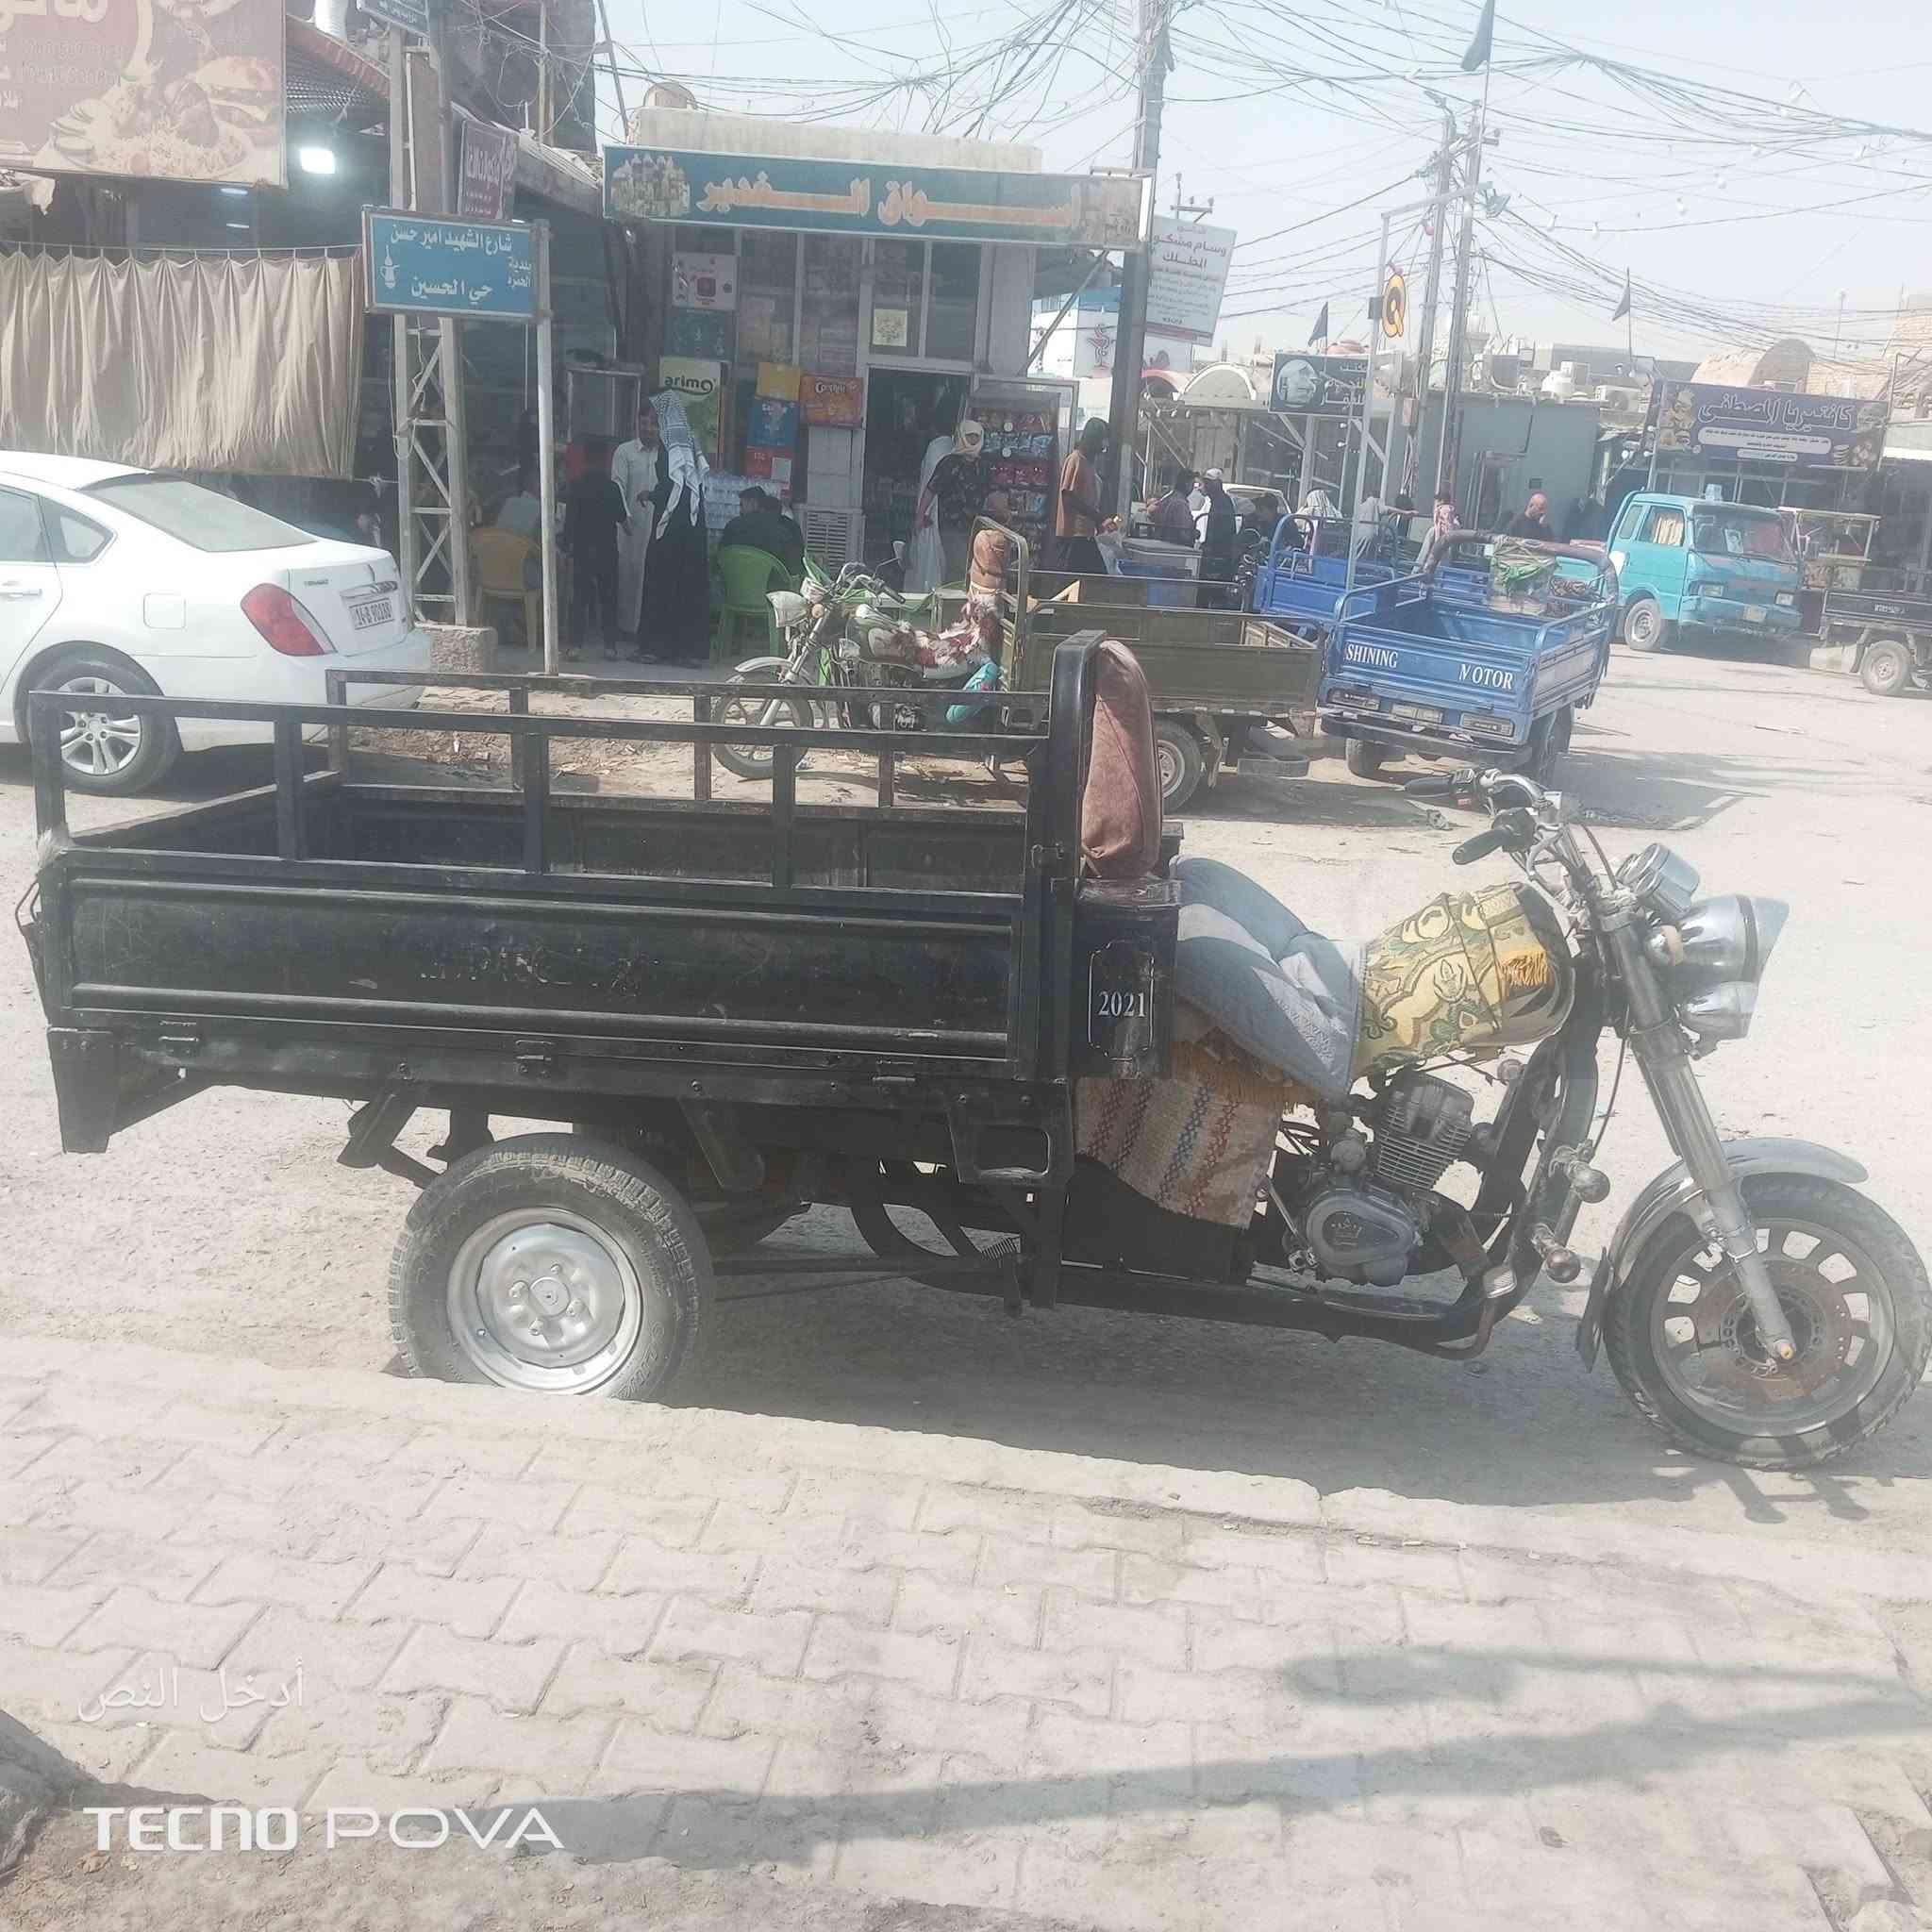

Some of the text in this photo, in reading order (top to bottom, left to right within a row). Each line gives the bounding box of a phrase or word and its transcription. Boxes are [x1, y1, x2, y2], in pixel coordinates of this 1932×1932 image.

[391, 224, 512, 256] شارع الشهيد امير حسن
[411, 275, 493, 305] حي الحسين
[1345, 642, 1399, 669] SHINING
[1098, 991, 1146, 1018] 2021
